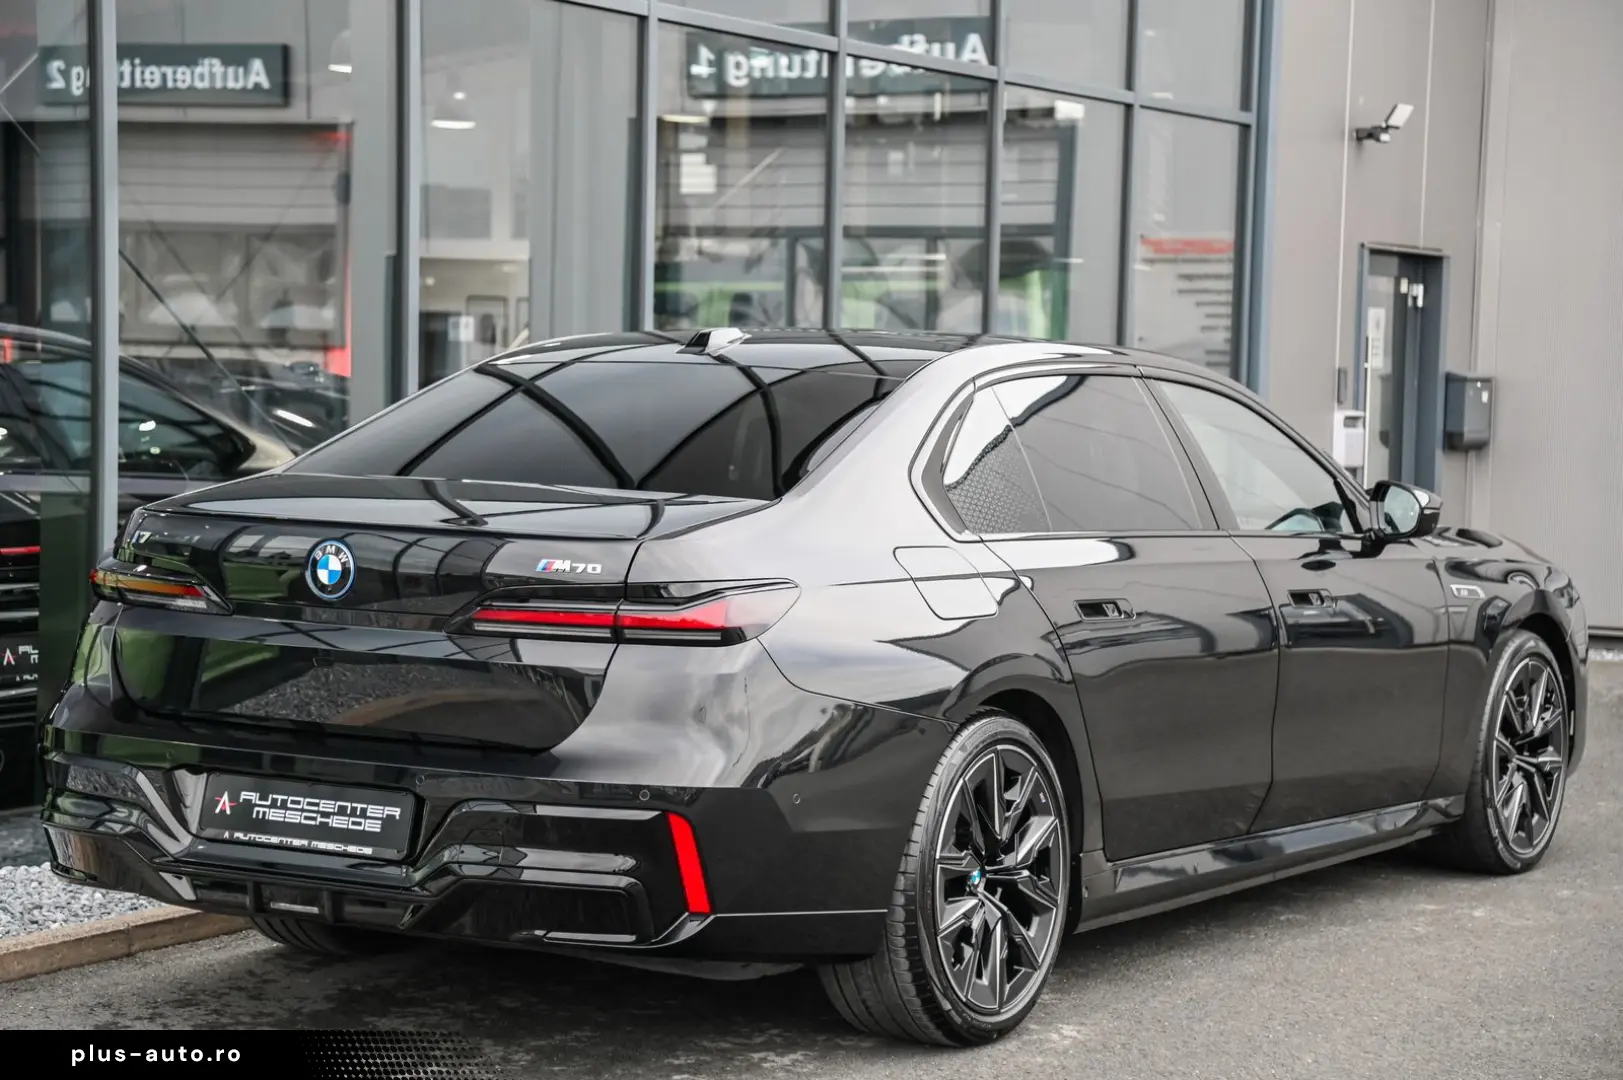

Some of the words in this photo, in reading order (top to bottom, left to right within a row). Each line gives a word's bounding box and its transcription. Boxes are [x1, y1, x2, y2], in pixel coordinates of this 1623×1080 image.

[314, 545, 349, 563] BMW
[239, 791, 401, 820] AUTOCENTER
[252, 806, 382, 832] MESCHEDE
[233, 834, 309, 847] AUTOCENTER
[310, 840, 373, 855] MESCHEDE
